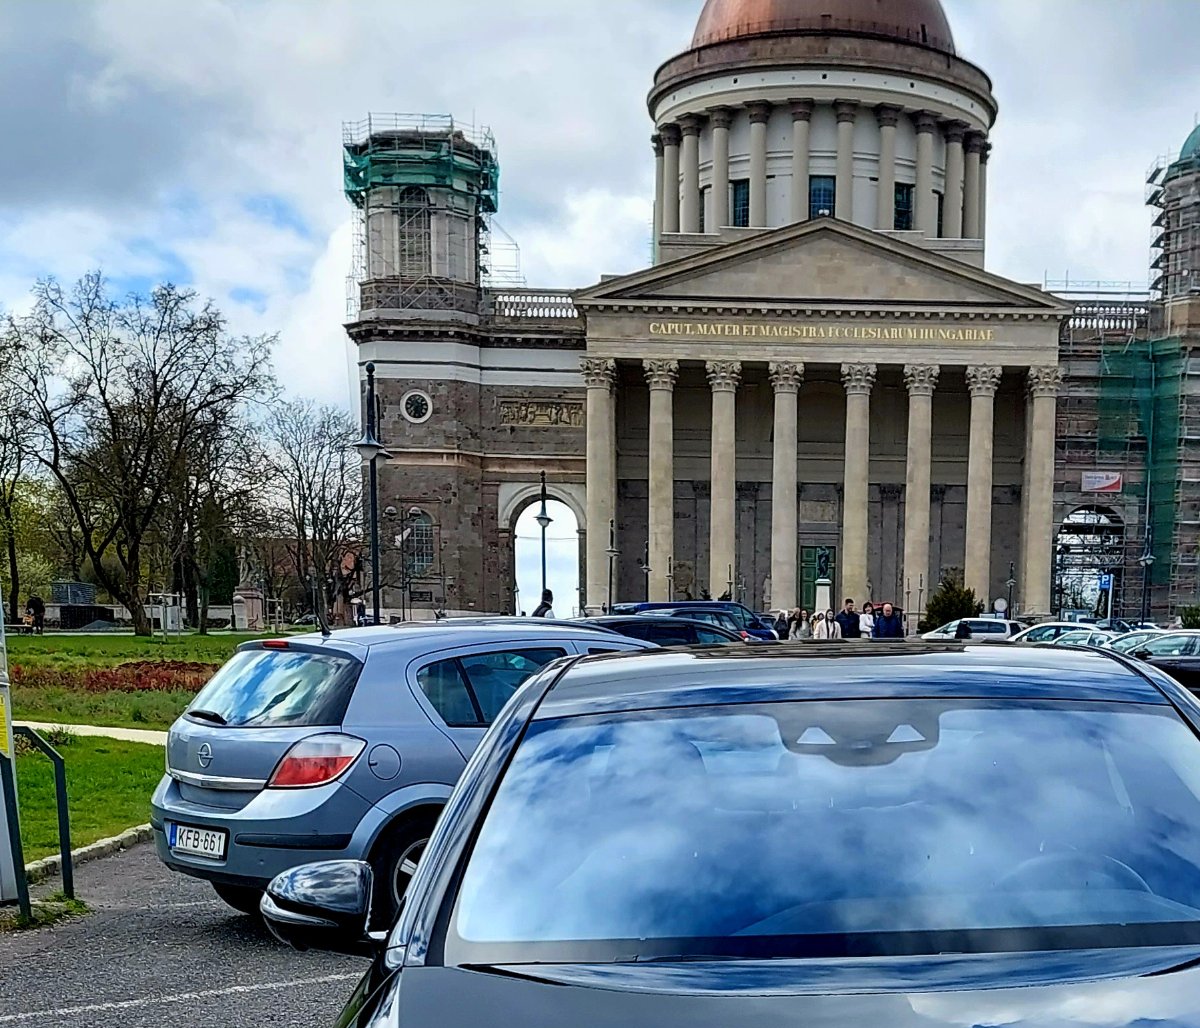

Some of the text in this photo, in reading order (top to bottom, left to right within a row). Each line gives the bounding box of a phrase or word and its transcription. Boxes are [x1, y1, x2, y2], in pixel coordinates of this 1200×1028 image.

[697, 323, 739, 336] MATER
[742, 324, 758, 336] ET
[759, 325, 825, 338] MAGISTRA
[920, 328, 994, 341] HUNGARIAE
[178, 827, 222, 853] KFB-661
